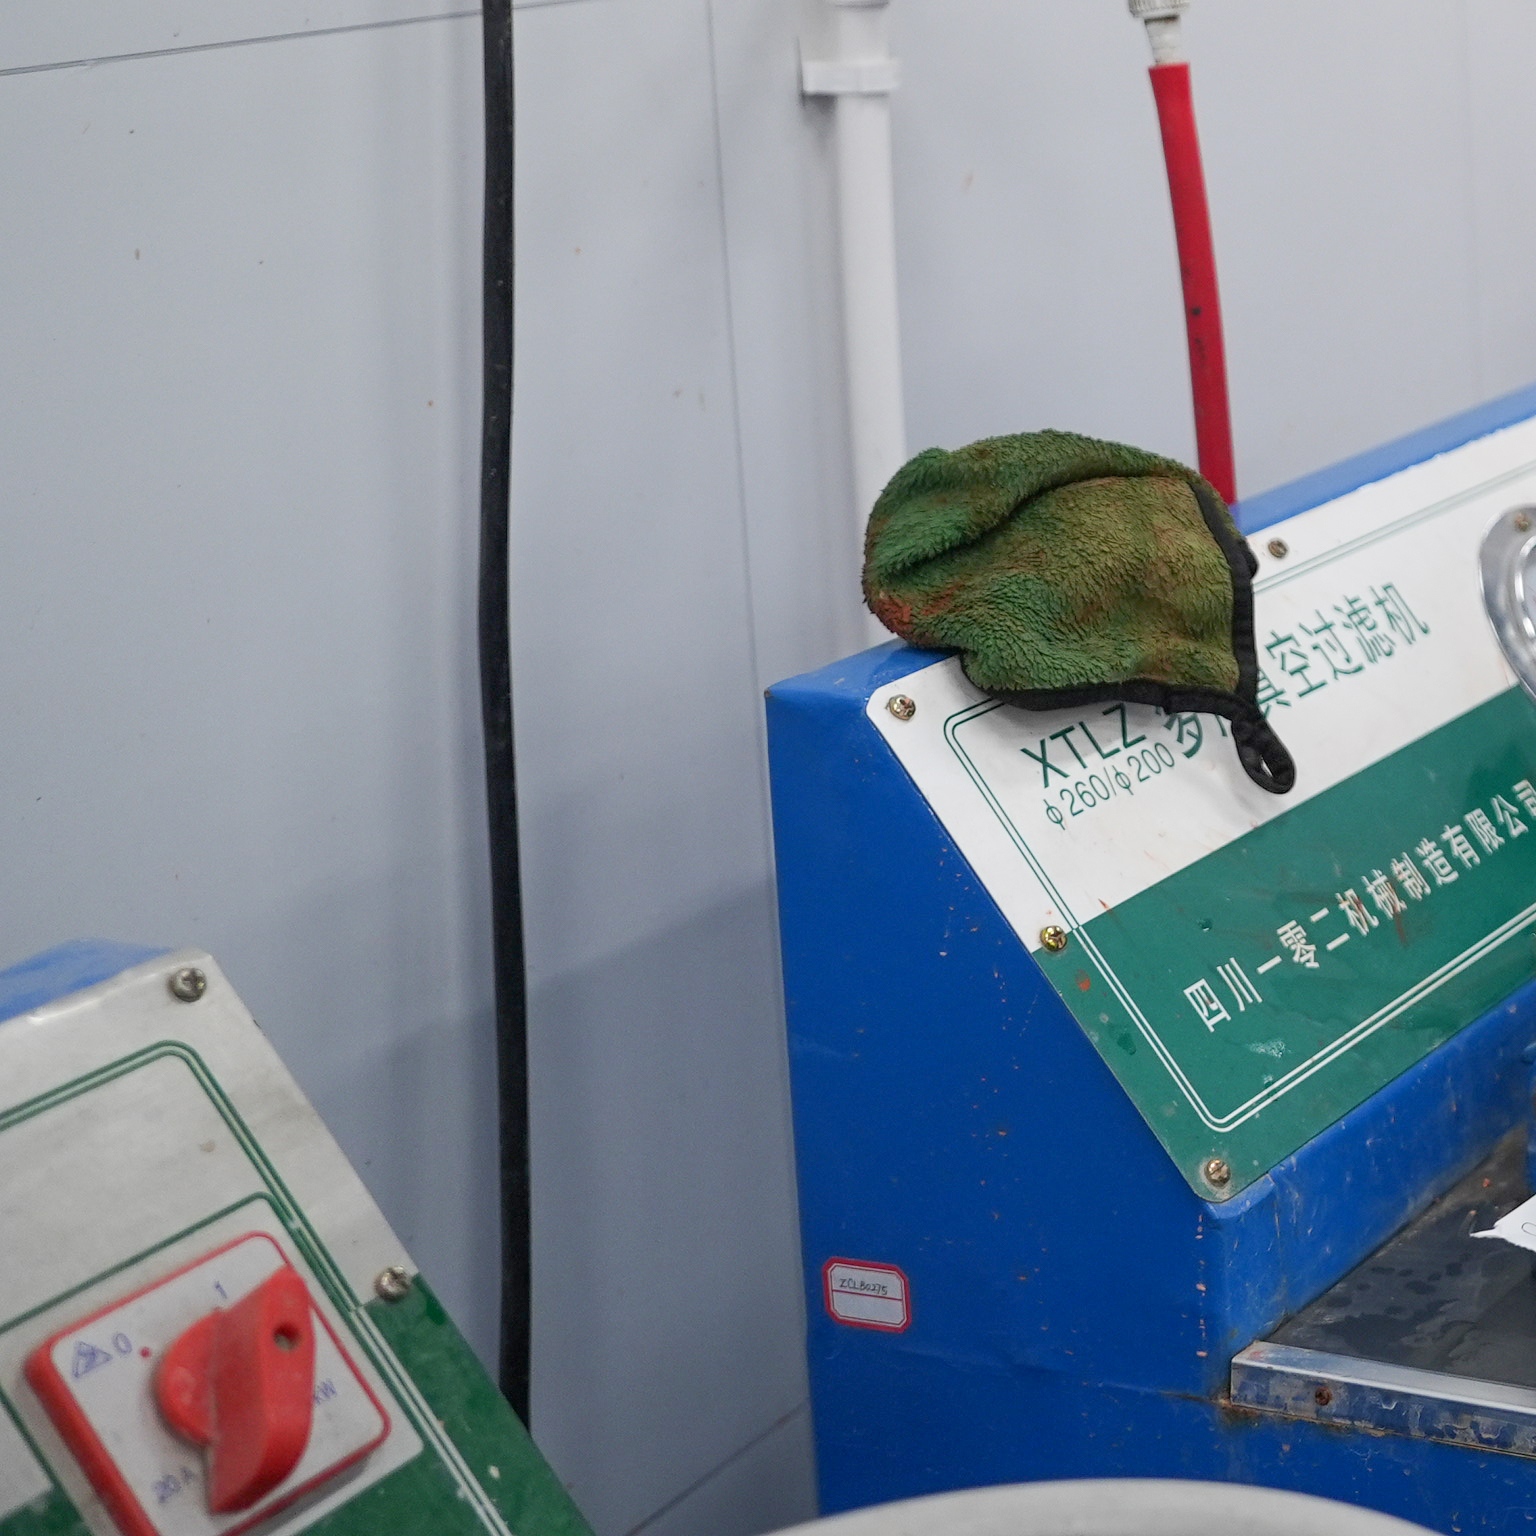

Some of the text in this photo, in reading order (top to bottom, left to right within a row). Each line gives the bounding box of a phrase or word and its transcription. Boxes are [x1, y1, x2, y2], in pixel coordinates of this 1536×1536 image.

[1020, 582, 1430, 788] XTLZ 多真空过滤机
